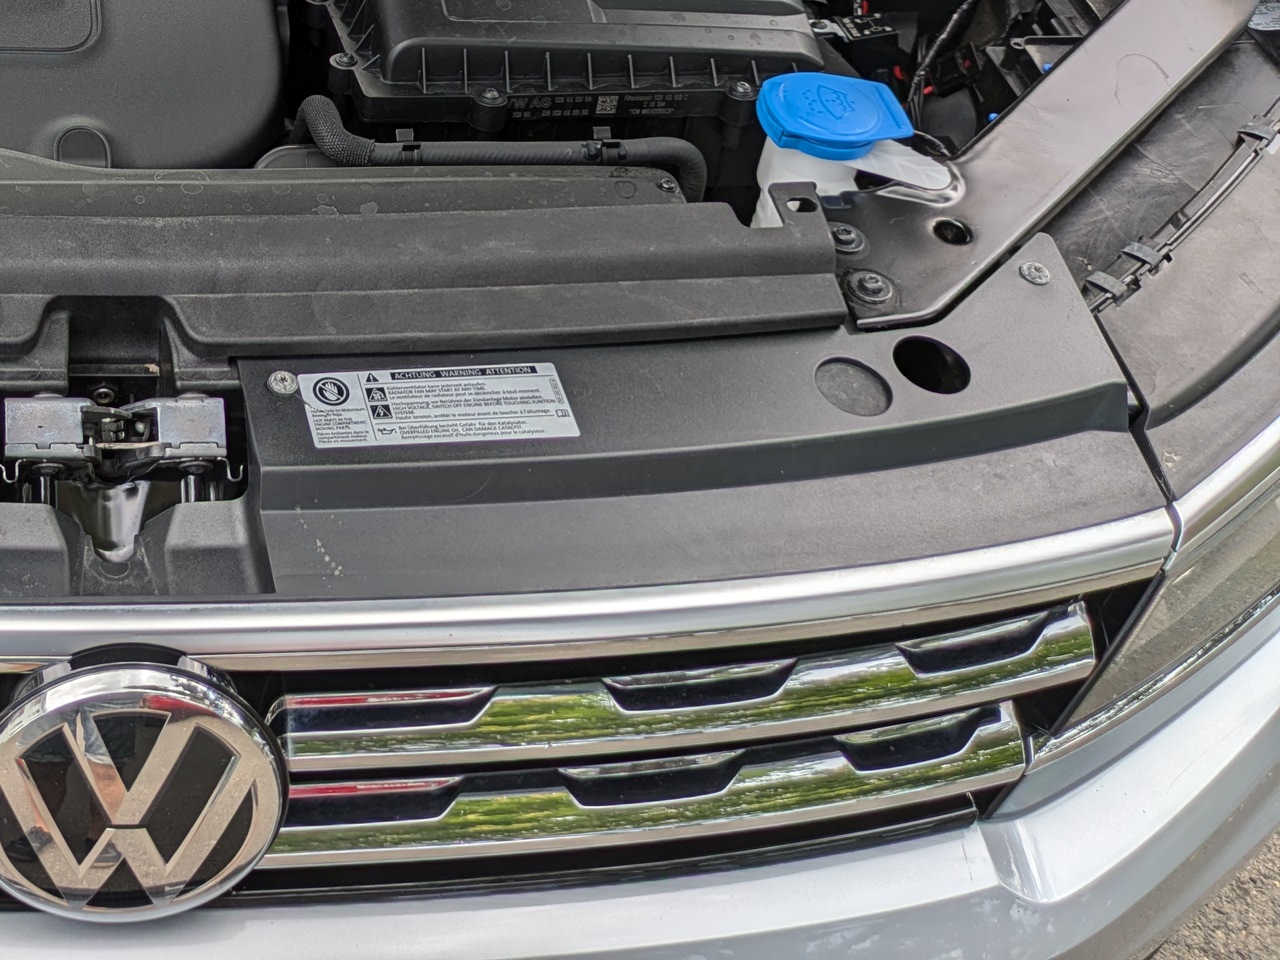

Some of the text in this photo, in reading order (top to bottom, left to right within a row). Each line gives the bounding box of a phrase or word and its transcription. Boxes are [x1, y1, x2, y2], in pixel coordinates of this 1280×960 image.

[394, 366, 531, 380] ACHTUNG WARNING ATTENTION
